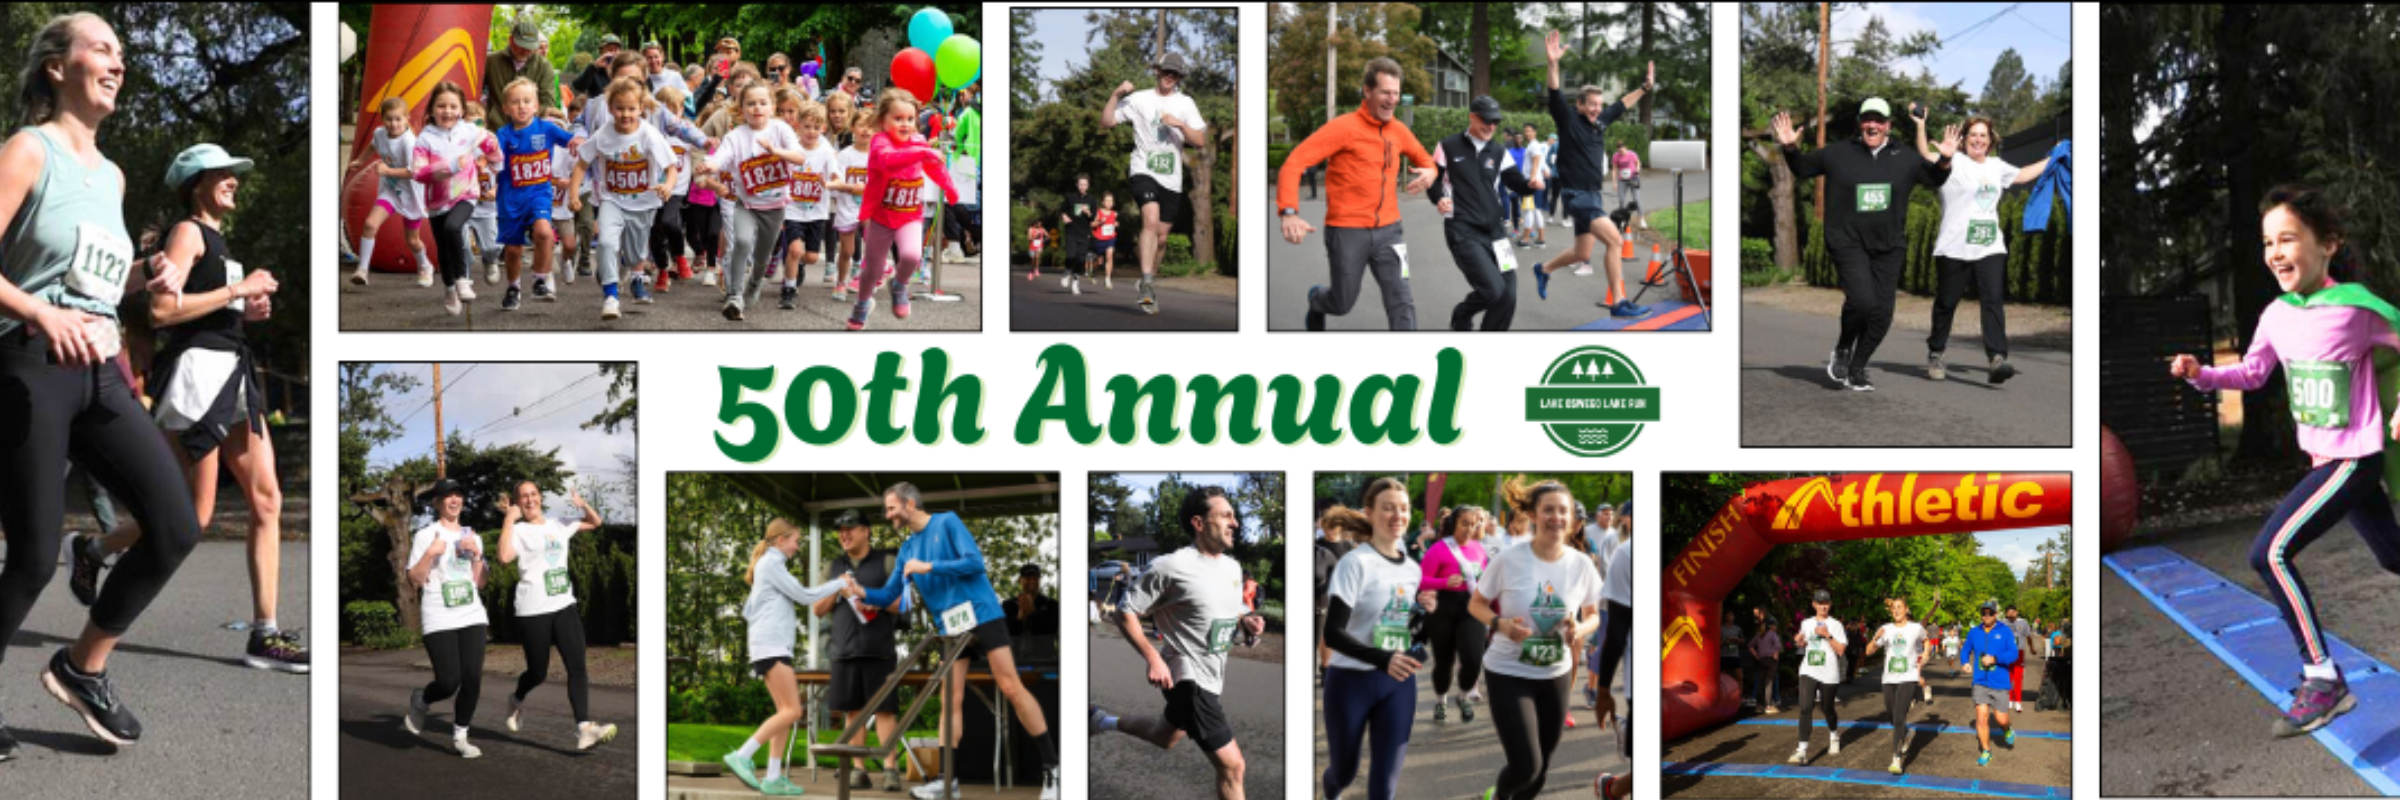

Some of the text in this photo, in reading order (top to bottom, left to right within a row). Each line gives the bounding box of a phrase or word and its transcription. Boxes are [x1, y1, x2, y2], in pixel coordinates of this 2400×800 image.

[512, 159, 551, 181] 1826
[606, 170, 649, 188] 4504
[744, 162, 788, 189] 1821
[80, 244, 126, 287] 1123
[2292, 376, 2335, 408] 500
[1672, 503, 1742, 587] FINISH
